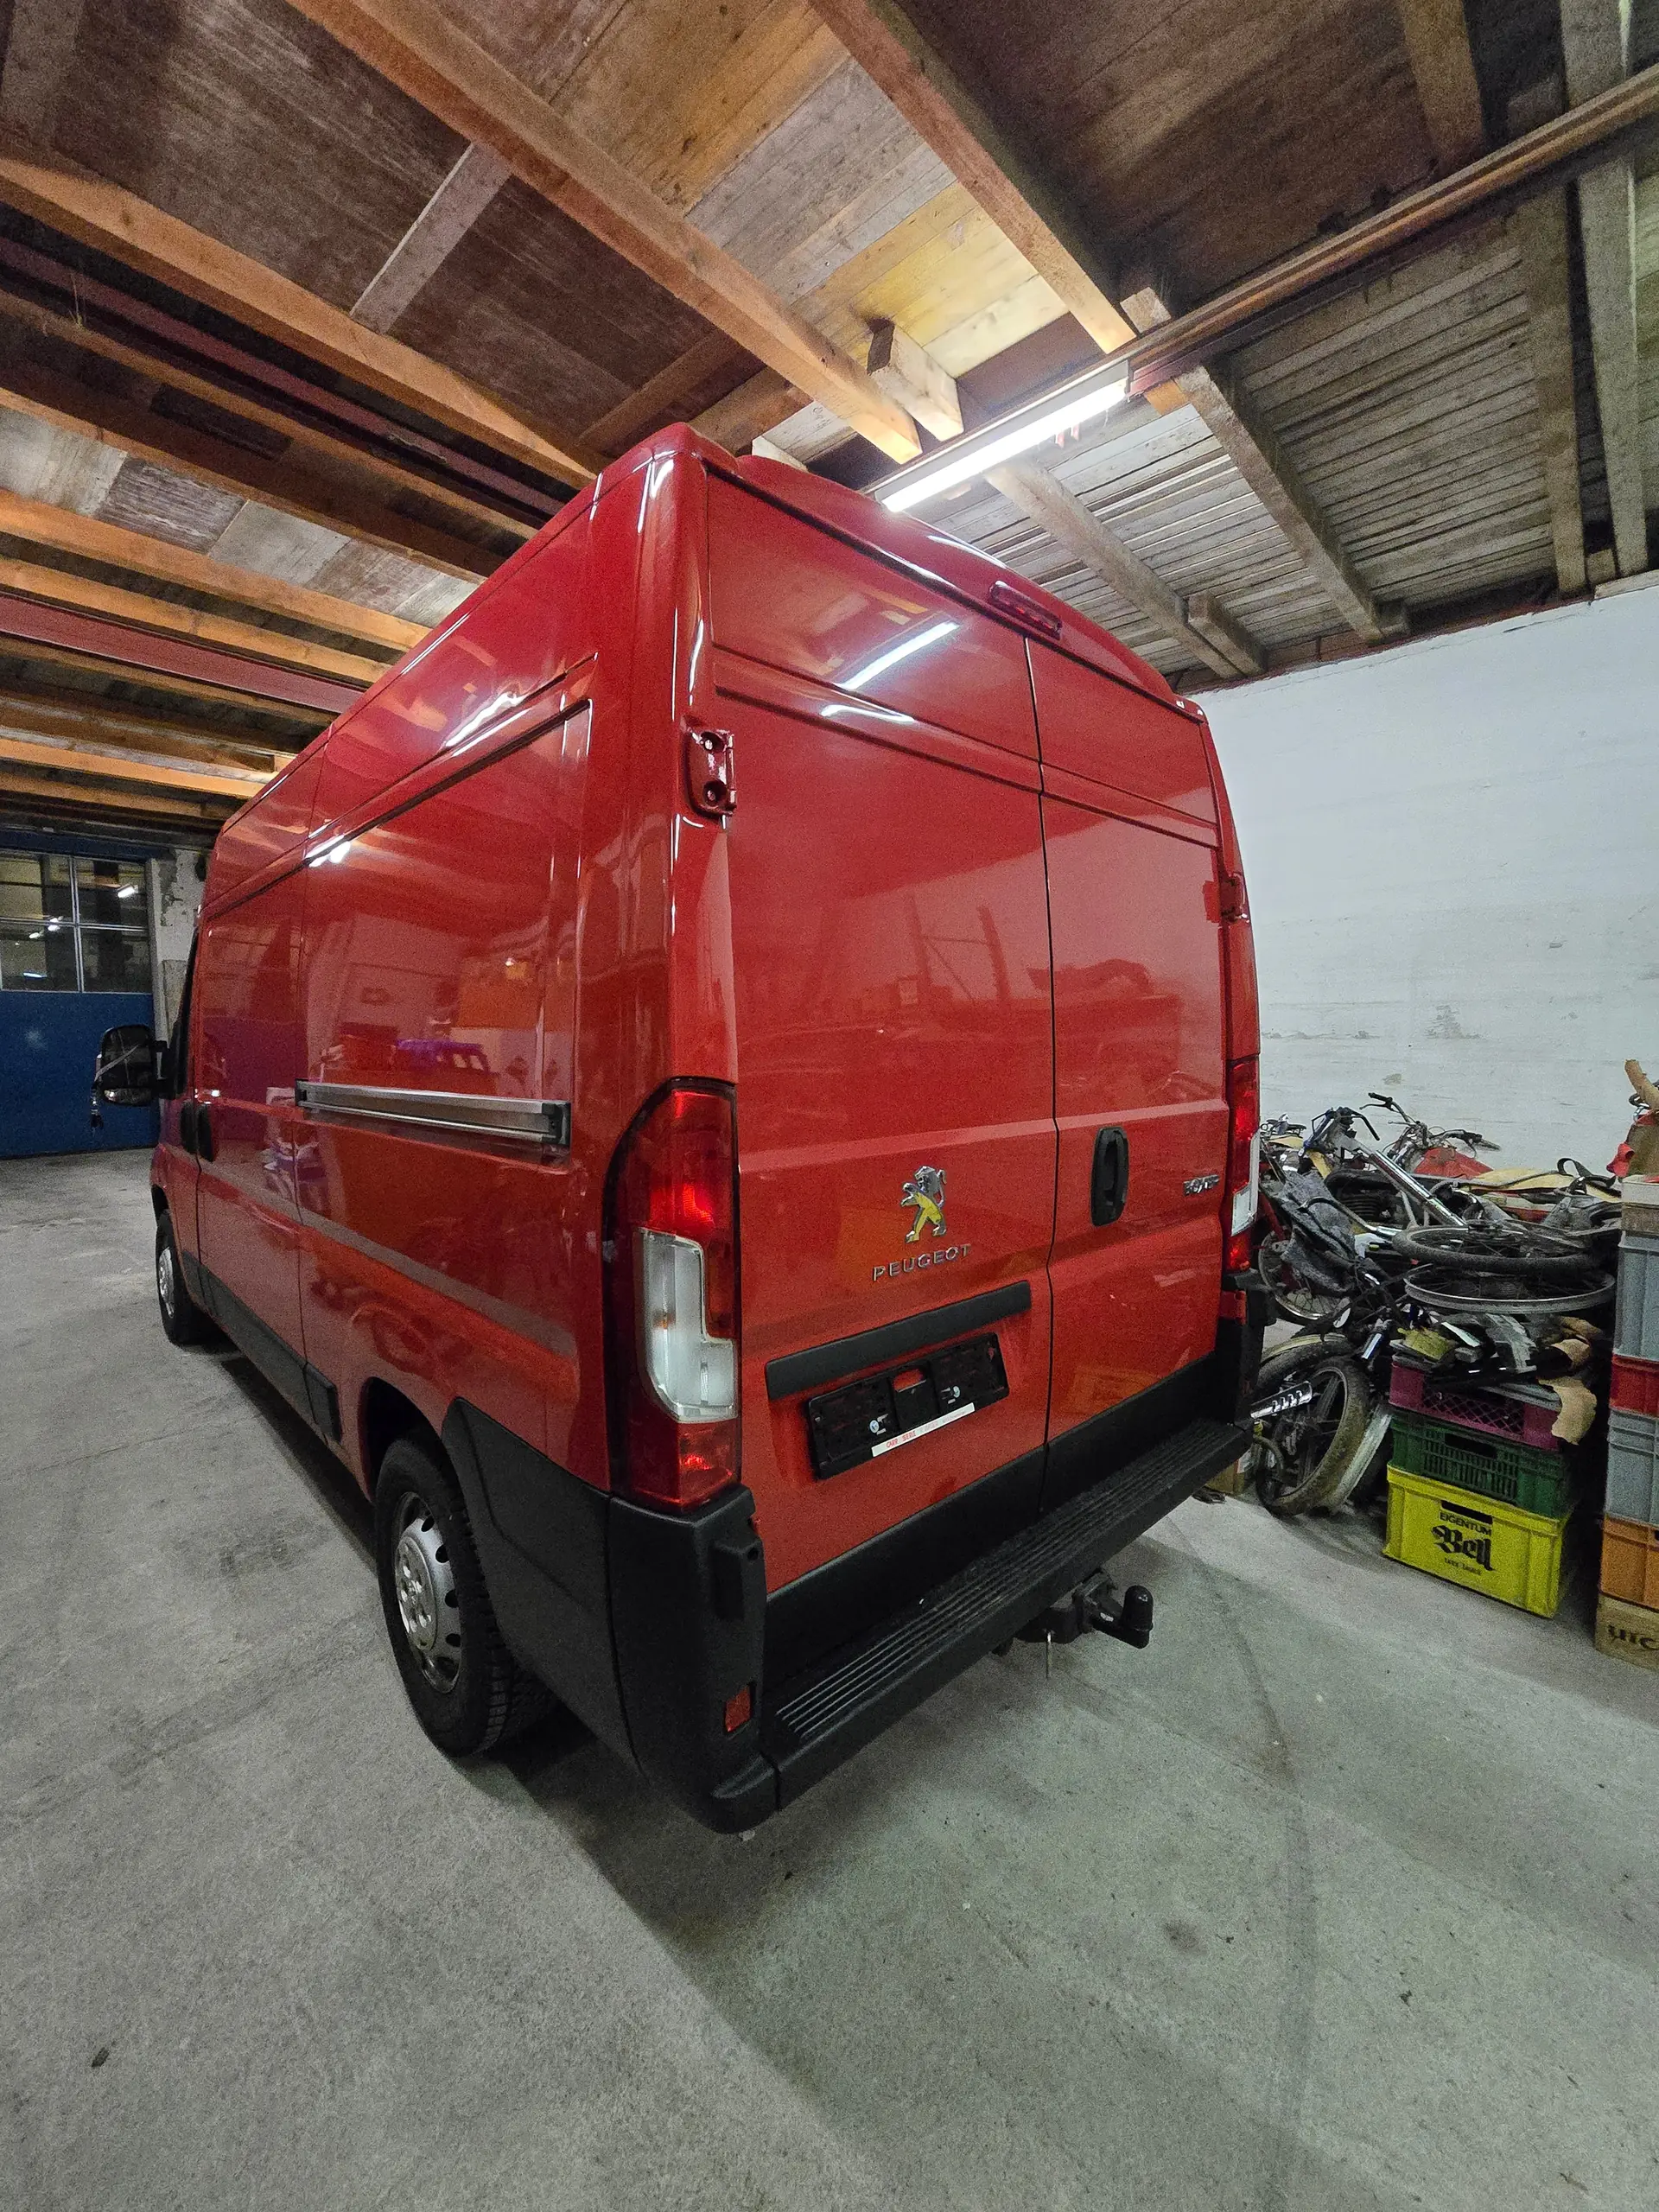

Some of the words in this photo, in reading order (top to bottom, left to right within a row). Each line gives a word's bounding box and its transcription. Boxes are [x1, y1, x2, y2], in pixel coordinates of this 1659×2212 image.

[872, 1243, 971, 1281] PEUGEOT
[1439, 1511, 1492, 1536] EIGENTUM
[1431, 1524, 1497, 1572] Bell
